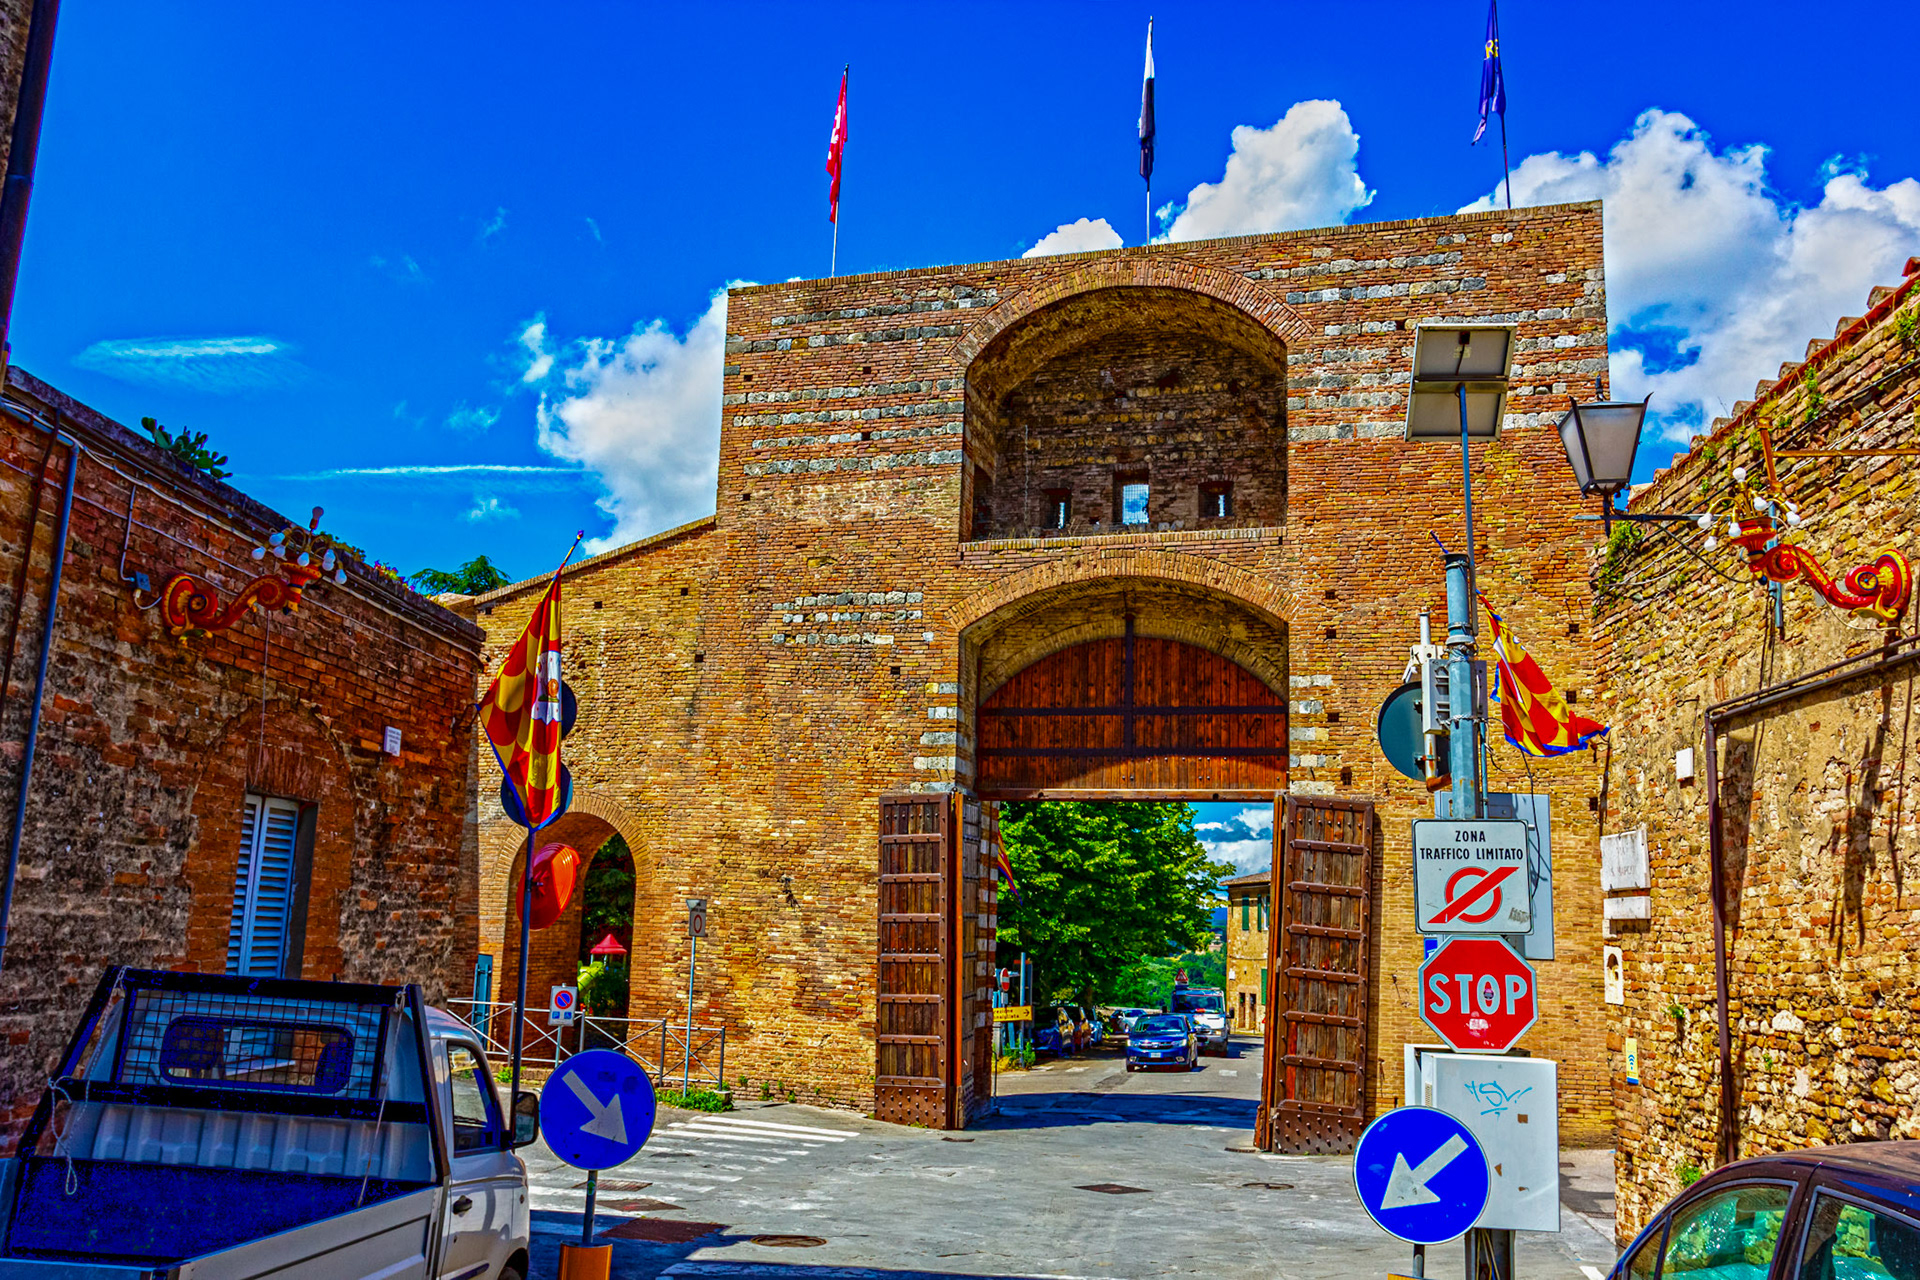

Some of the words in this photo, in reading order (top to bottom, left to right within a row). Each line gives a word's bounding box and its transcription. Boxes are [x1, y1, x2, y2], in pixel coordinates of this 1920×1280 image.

[1455, 830, 1486, 843] ZONA
[1419, 847, 1470, 860] TRAFFICO
[1476, 847, 1524, 860] LIMITATO
[1428, 972, 1528, 1015] STOP
